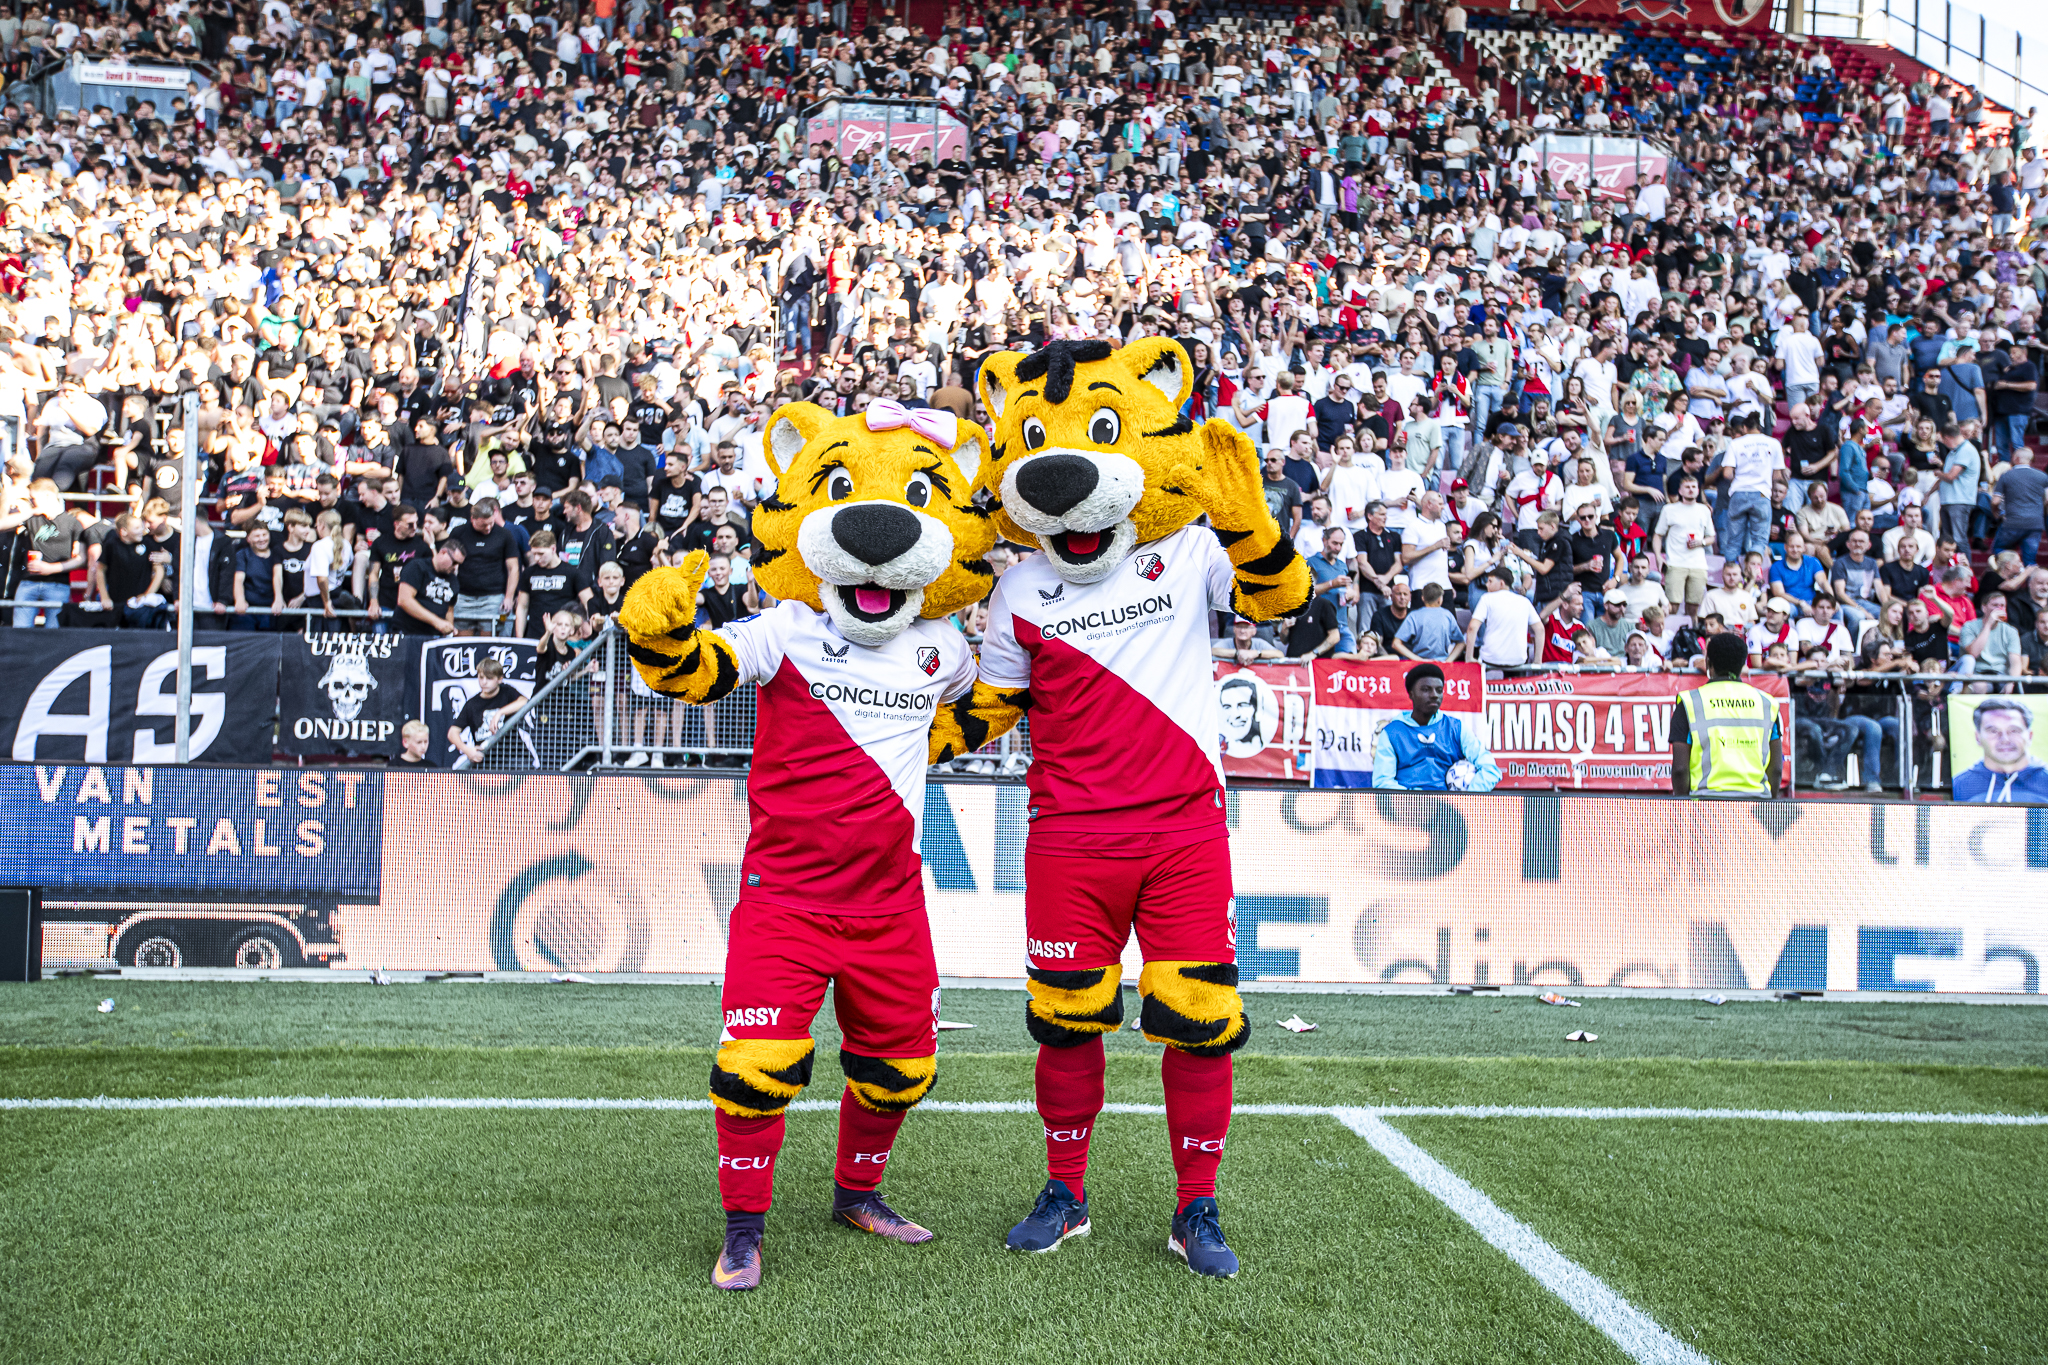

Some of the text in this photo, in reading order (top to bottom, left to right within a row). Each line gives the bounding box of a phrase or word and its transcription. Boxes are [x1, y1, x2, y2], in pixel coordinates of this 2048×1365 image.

[1041, 594, 1173, 639] CONCLUSION
[1086, 614, 1175, 641] digital transformation
[1326, 670, 1391, 697] Forza
[810, 682, 934, 710] CONCLUSION
[1709, 698, 1755, 708] STEWARD
[854, 709, 881, 719] digital
[294, 717, 395, 741] ONDIEP
[1604, 704, 1626, 752] 4
[1632, 704, 1677, 752] EV
[1509, 761, 1525, 777] De
[1590, 763, 1655, 778] november
[35, 766, 366, 809] VAN EST
[73, 815, 327, 857] METALS
[1028, 938, 1078, 959] DASSY
[726, 1007, 782, 1027] DASSY
[1044, 1126, 1087, 1142] FCU
[719, 1155, 770, 1170] FCU
[854, 1150, 891, 1164] FC
